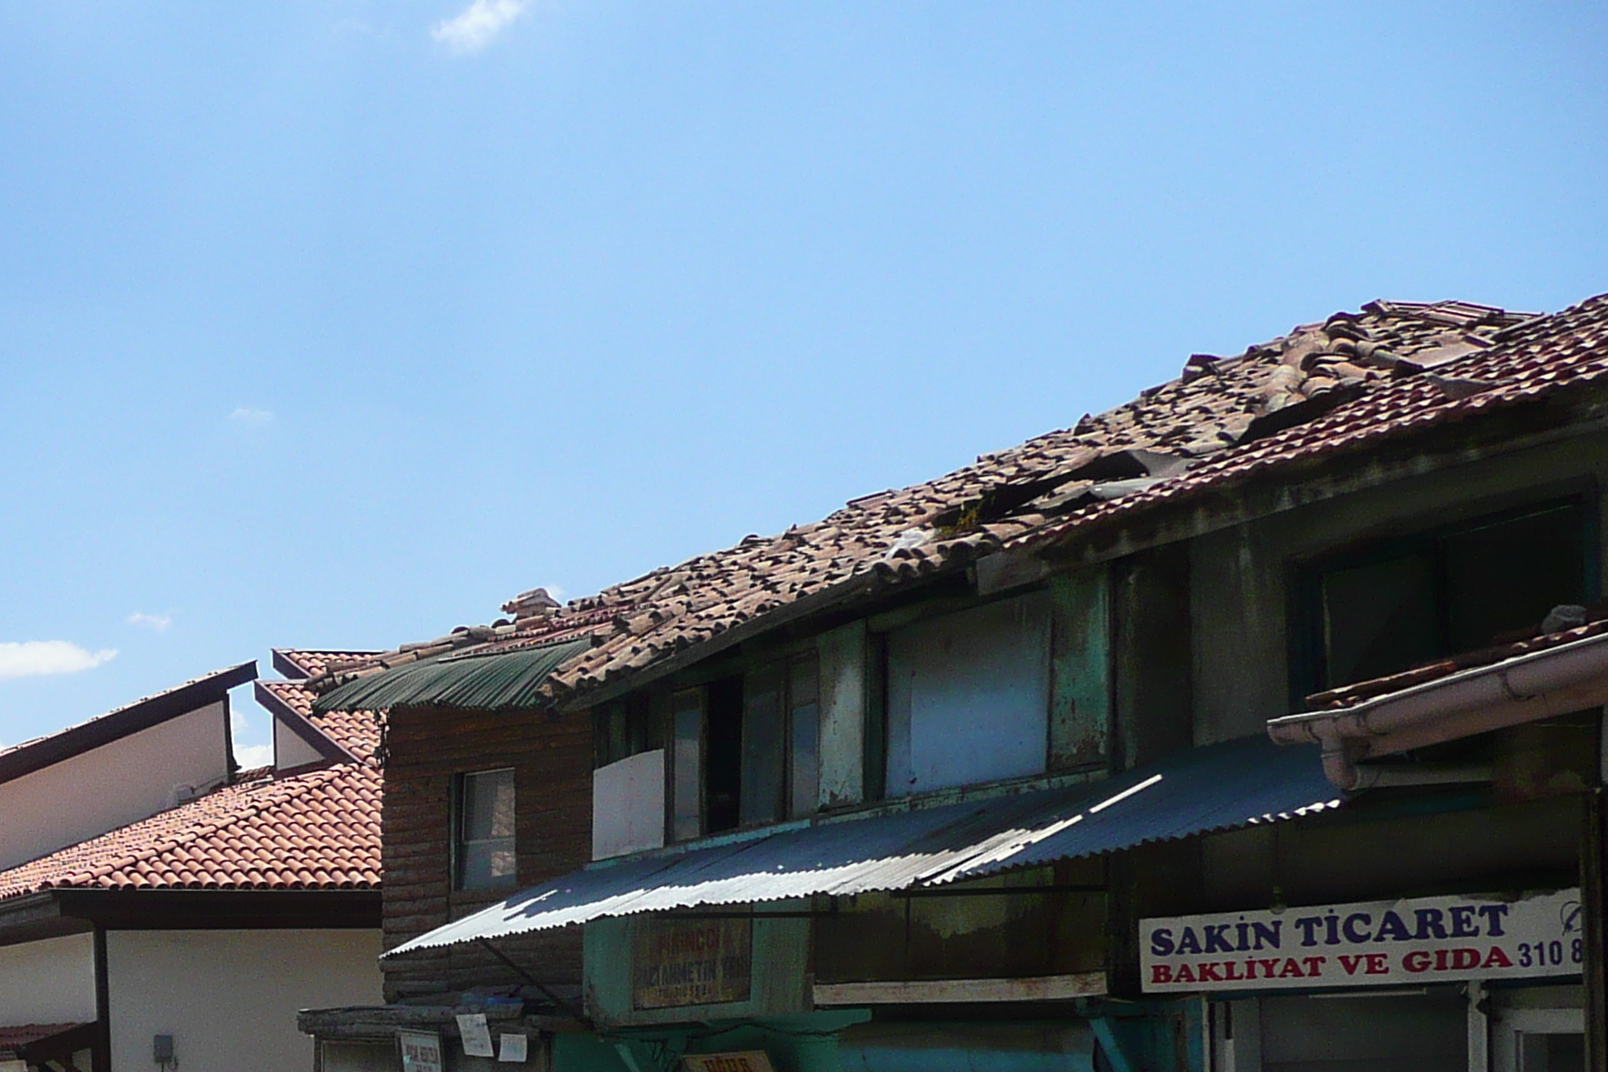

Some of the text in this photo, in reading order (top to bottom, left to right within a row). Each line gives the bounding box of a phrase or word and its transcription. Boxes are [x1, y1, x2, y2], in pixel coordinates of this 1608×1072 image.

[1149, 902, 1510, 957] SAKİN TİCARET
[1150, 955, 1328, 984] BAKLİYAT
[1337, 952, 1390, 975] VE
[1401, 944, 1515, 973] GIDA
[1517, 939, 1563, 968] 310
